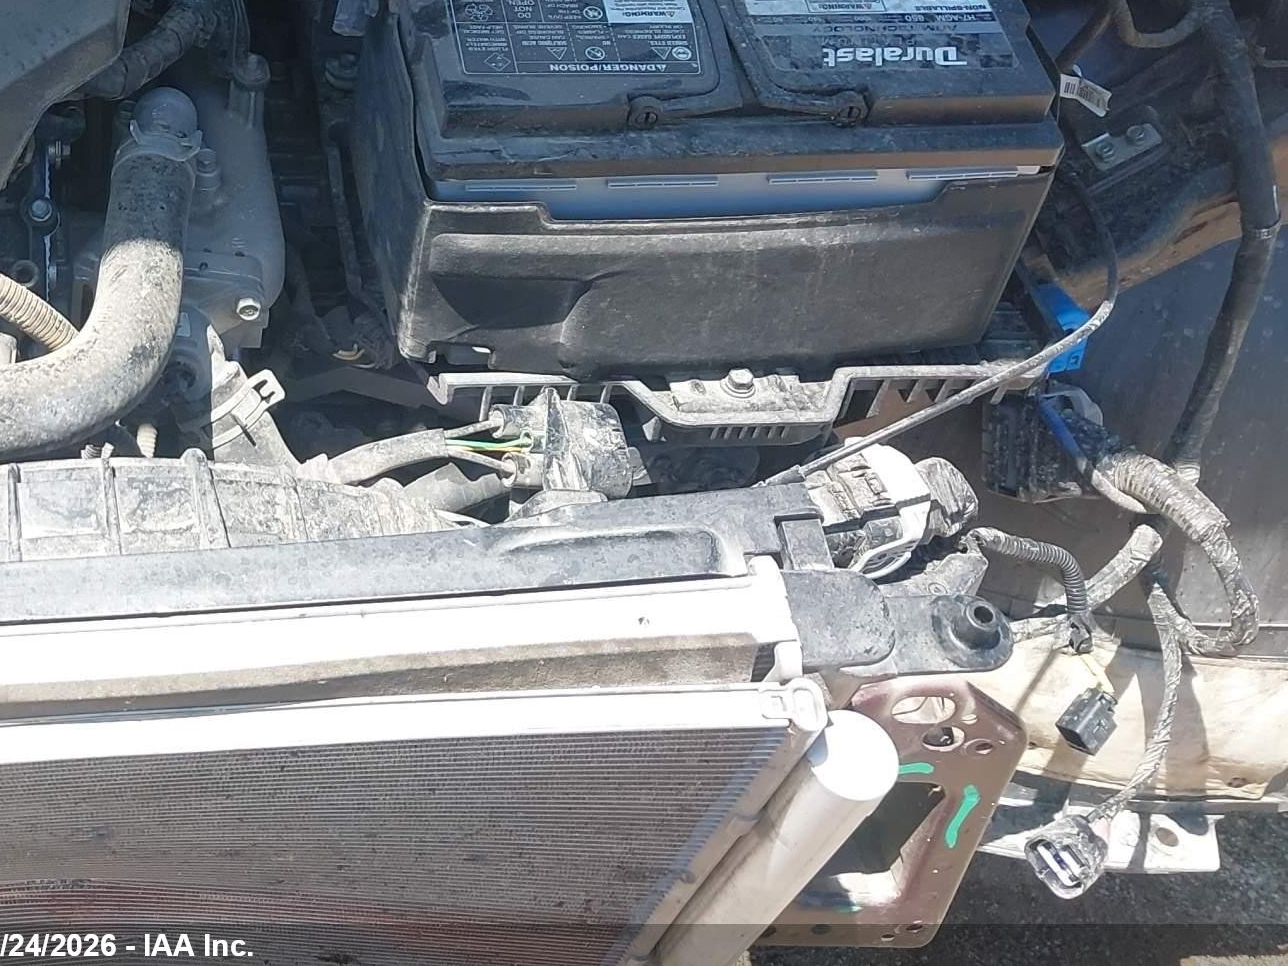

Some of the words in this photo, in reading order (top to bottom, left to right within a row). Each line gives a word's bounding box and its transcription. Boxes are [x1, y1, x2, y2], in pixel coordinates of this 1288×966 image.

[513, 5, 532, 13] NOT
[935, 14, 976, 22] H7-AGM
[823, 46, 968, 67] Duralast
[549, 63, 657, 72] DANGER/POISON
